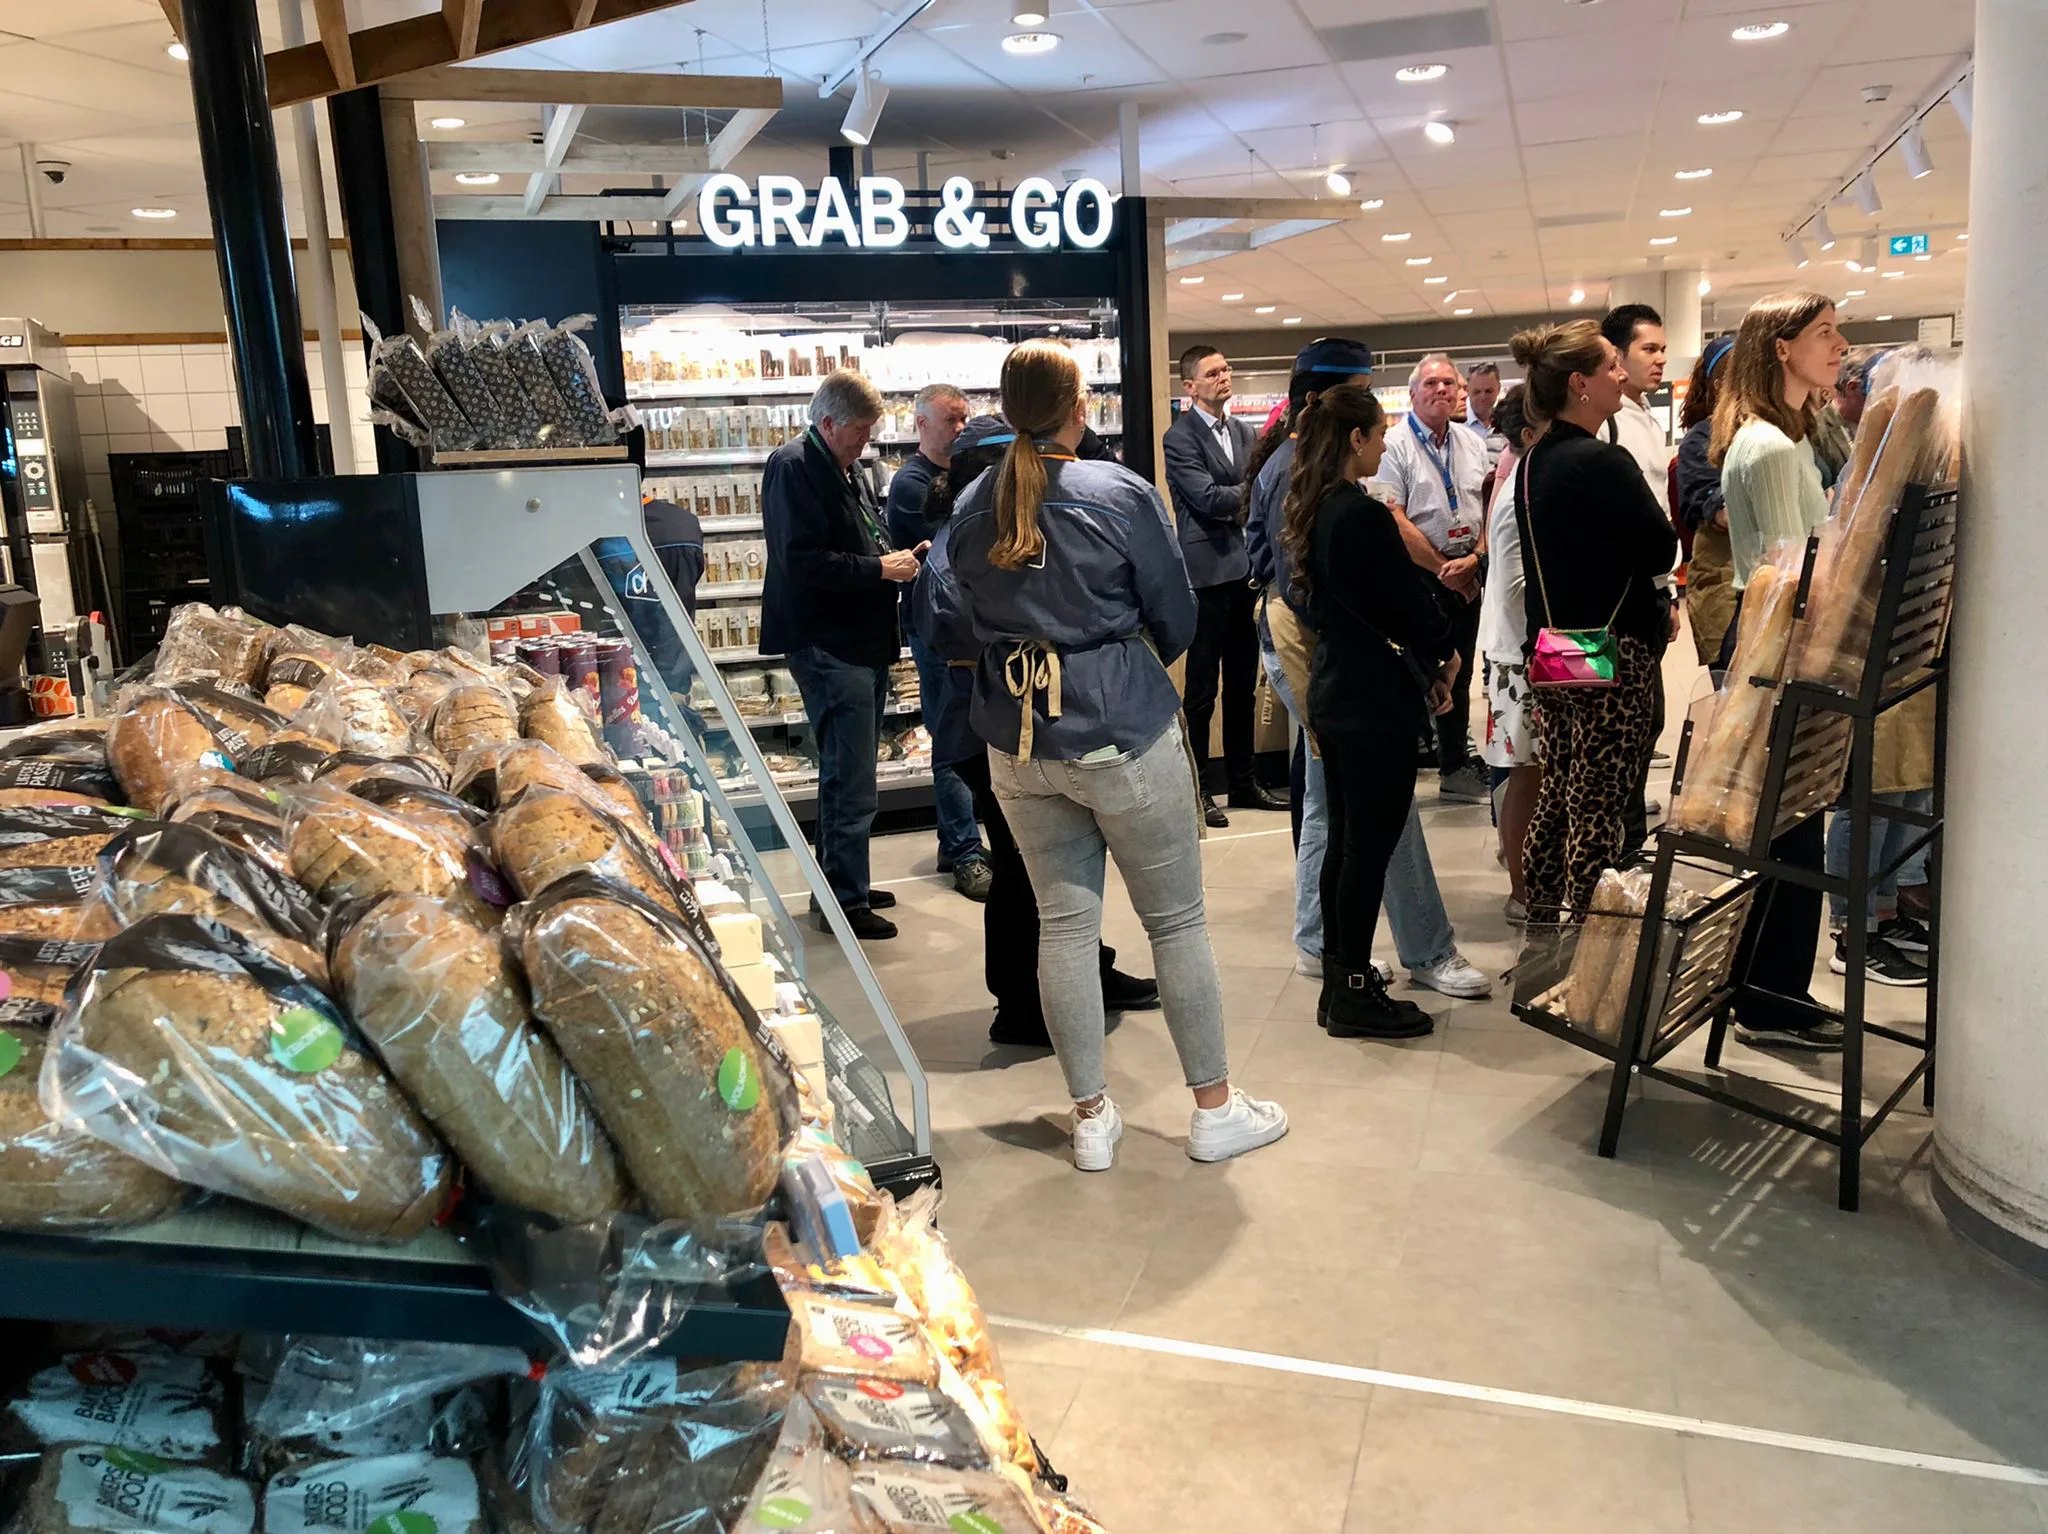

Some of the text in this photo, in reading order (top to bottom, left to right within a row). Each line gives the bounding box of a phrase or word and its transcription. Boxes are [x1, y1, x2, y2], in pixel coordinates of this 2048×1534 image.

[699, 173, 1114, 248] GRAB & GO
